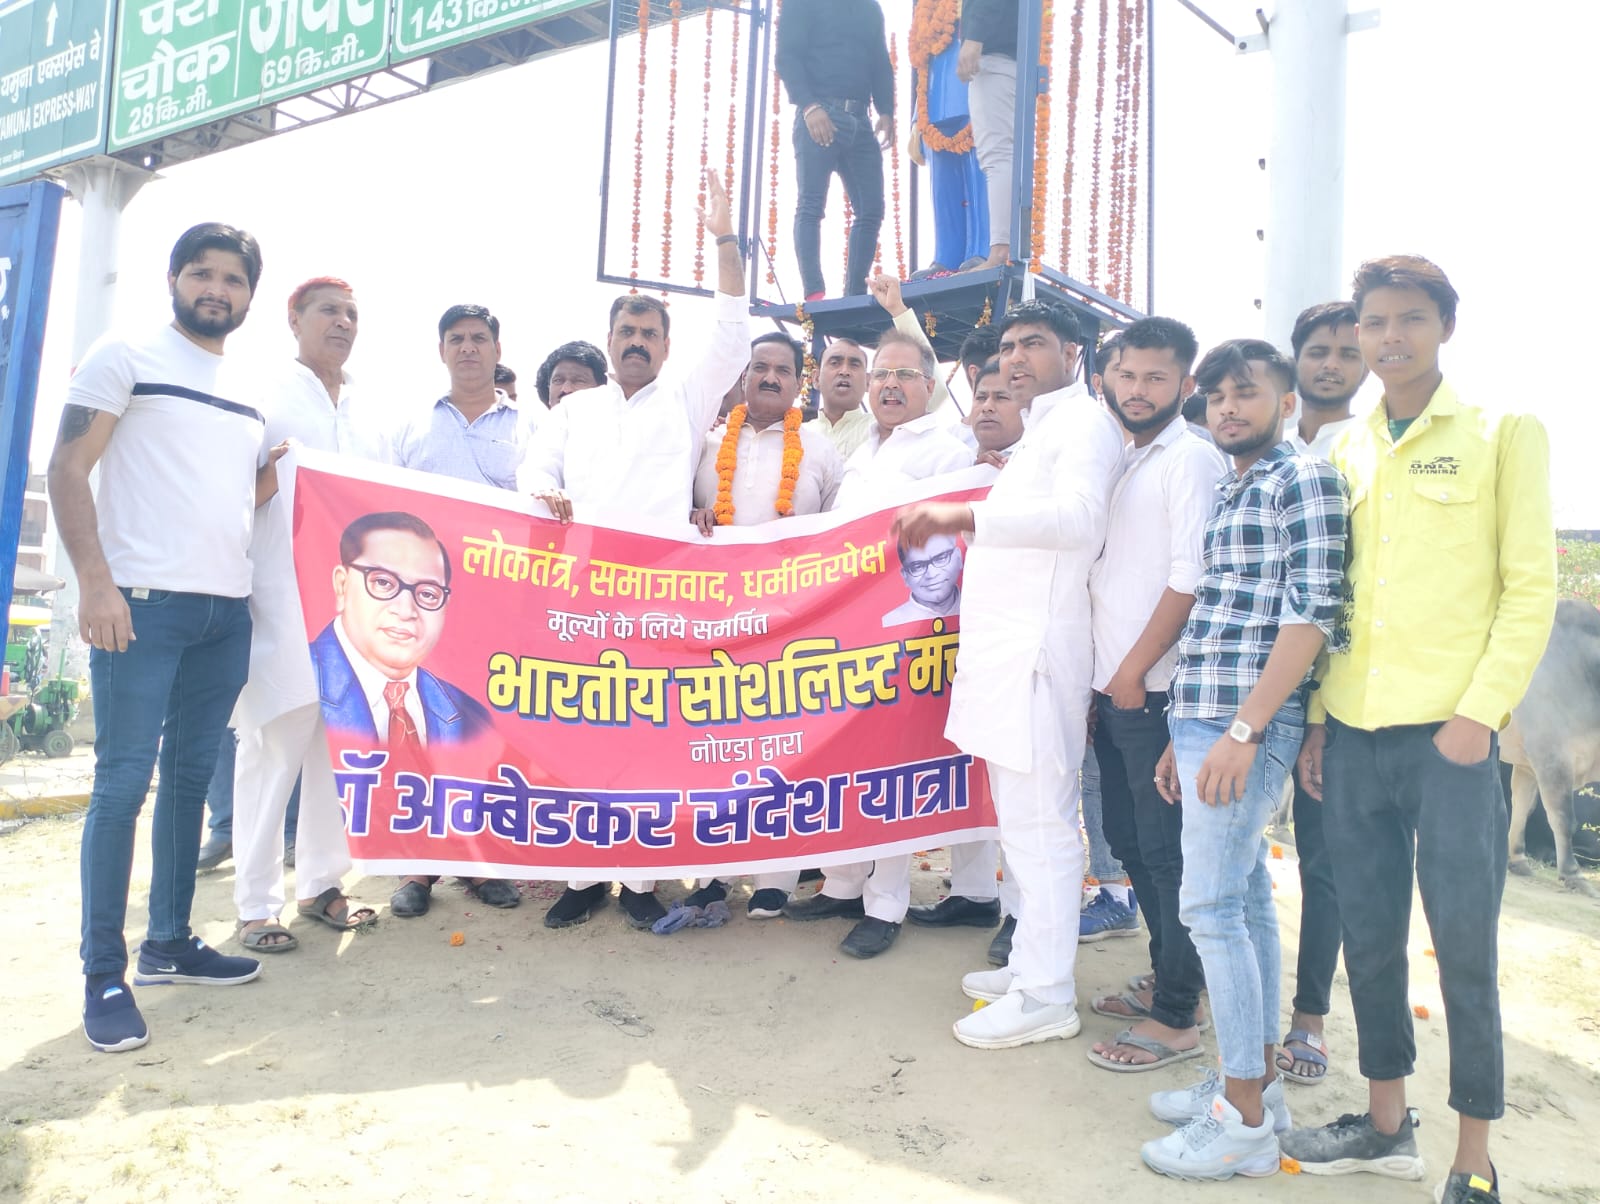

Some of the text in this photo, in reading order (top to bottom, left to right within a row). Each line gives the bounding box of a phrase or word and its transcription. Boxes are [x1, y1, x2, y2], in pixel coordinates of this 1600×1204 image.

[121, 31, 237, 100] चौक
[0, 106, 31, 141] AMUNA
[741, 540, 888, 599] धर्मनिरपेक्ष
[546, 607, 769, 643] मूल्यों के लिये समर्पित
[486, 649, 671, 726] भारतीय
[674, 638, 903, 727] सोशलिस्ट
[688, 730, 804, 764] नोएडा द्वारा
[389, 764, 684, 848] अम्बेडकर
[689, 765, 850, 845] संदेश
[855, 751, 975, 822] यात्रा
